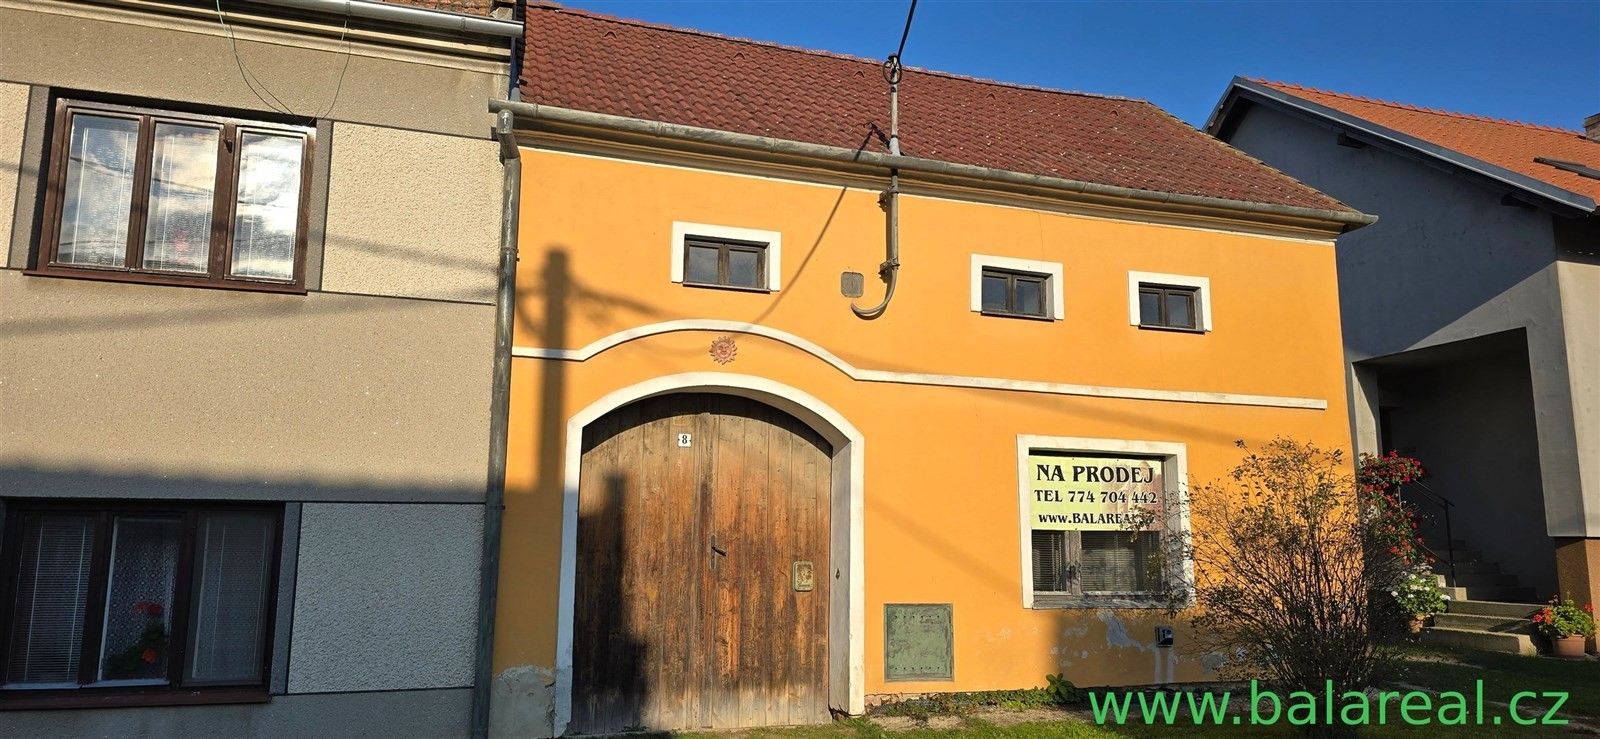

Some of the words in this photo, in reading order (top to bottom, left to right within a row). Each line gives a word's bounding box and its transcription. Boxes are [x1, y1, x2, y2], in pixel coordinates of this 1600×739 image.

[681, 434, 688, 444] 8
[1036, 464, 1065, 482] NA
[1072, 465, 1154, 483] PRODEJ
[1034, 489, 1063, 503] TEL
[1068, 490, 1095, 503] 774
[1100, 491, 1126, 504] 704
[1131, 492, 1157, 504] 442
